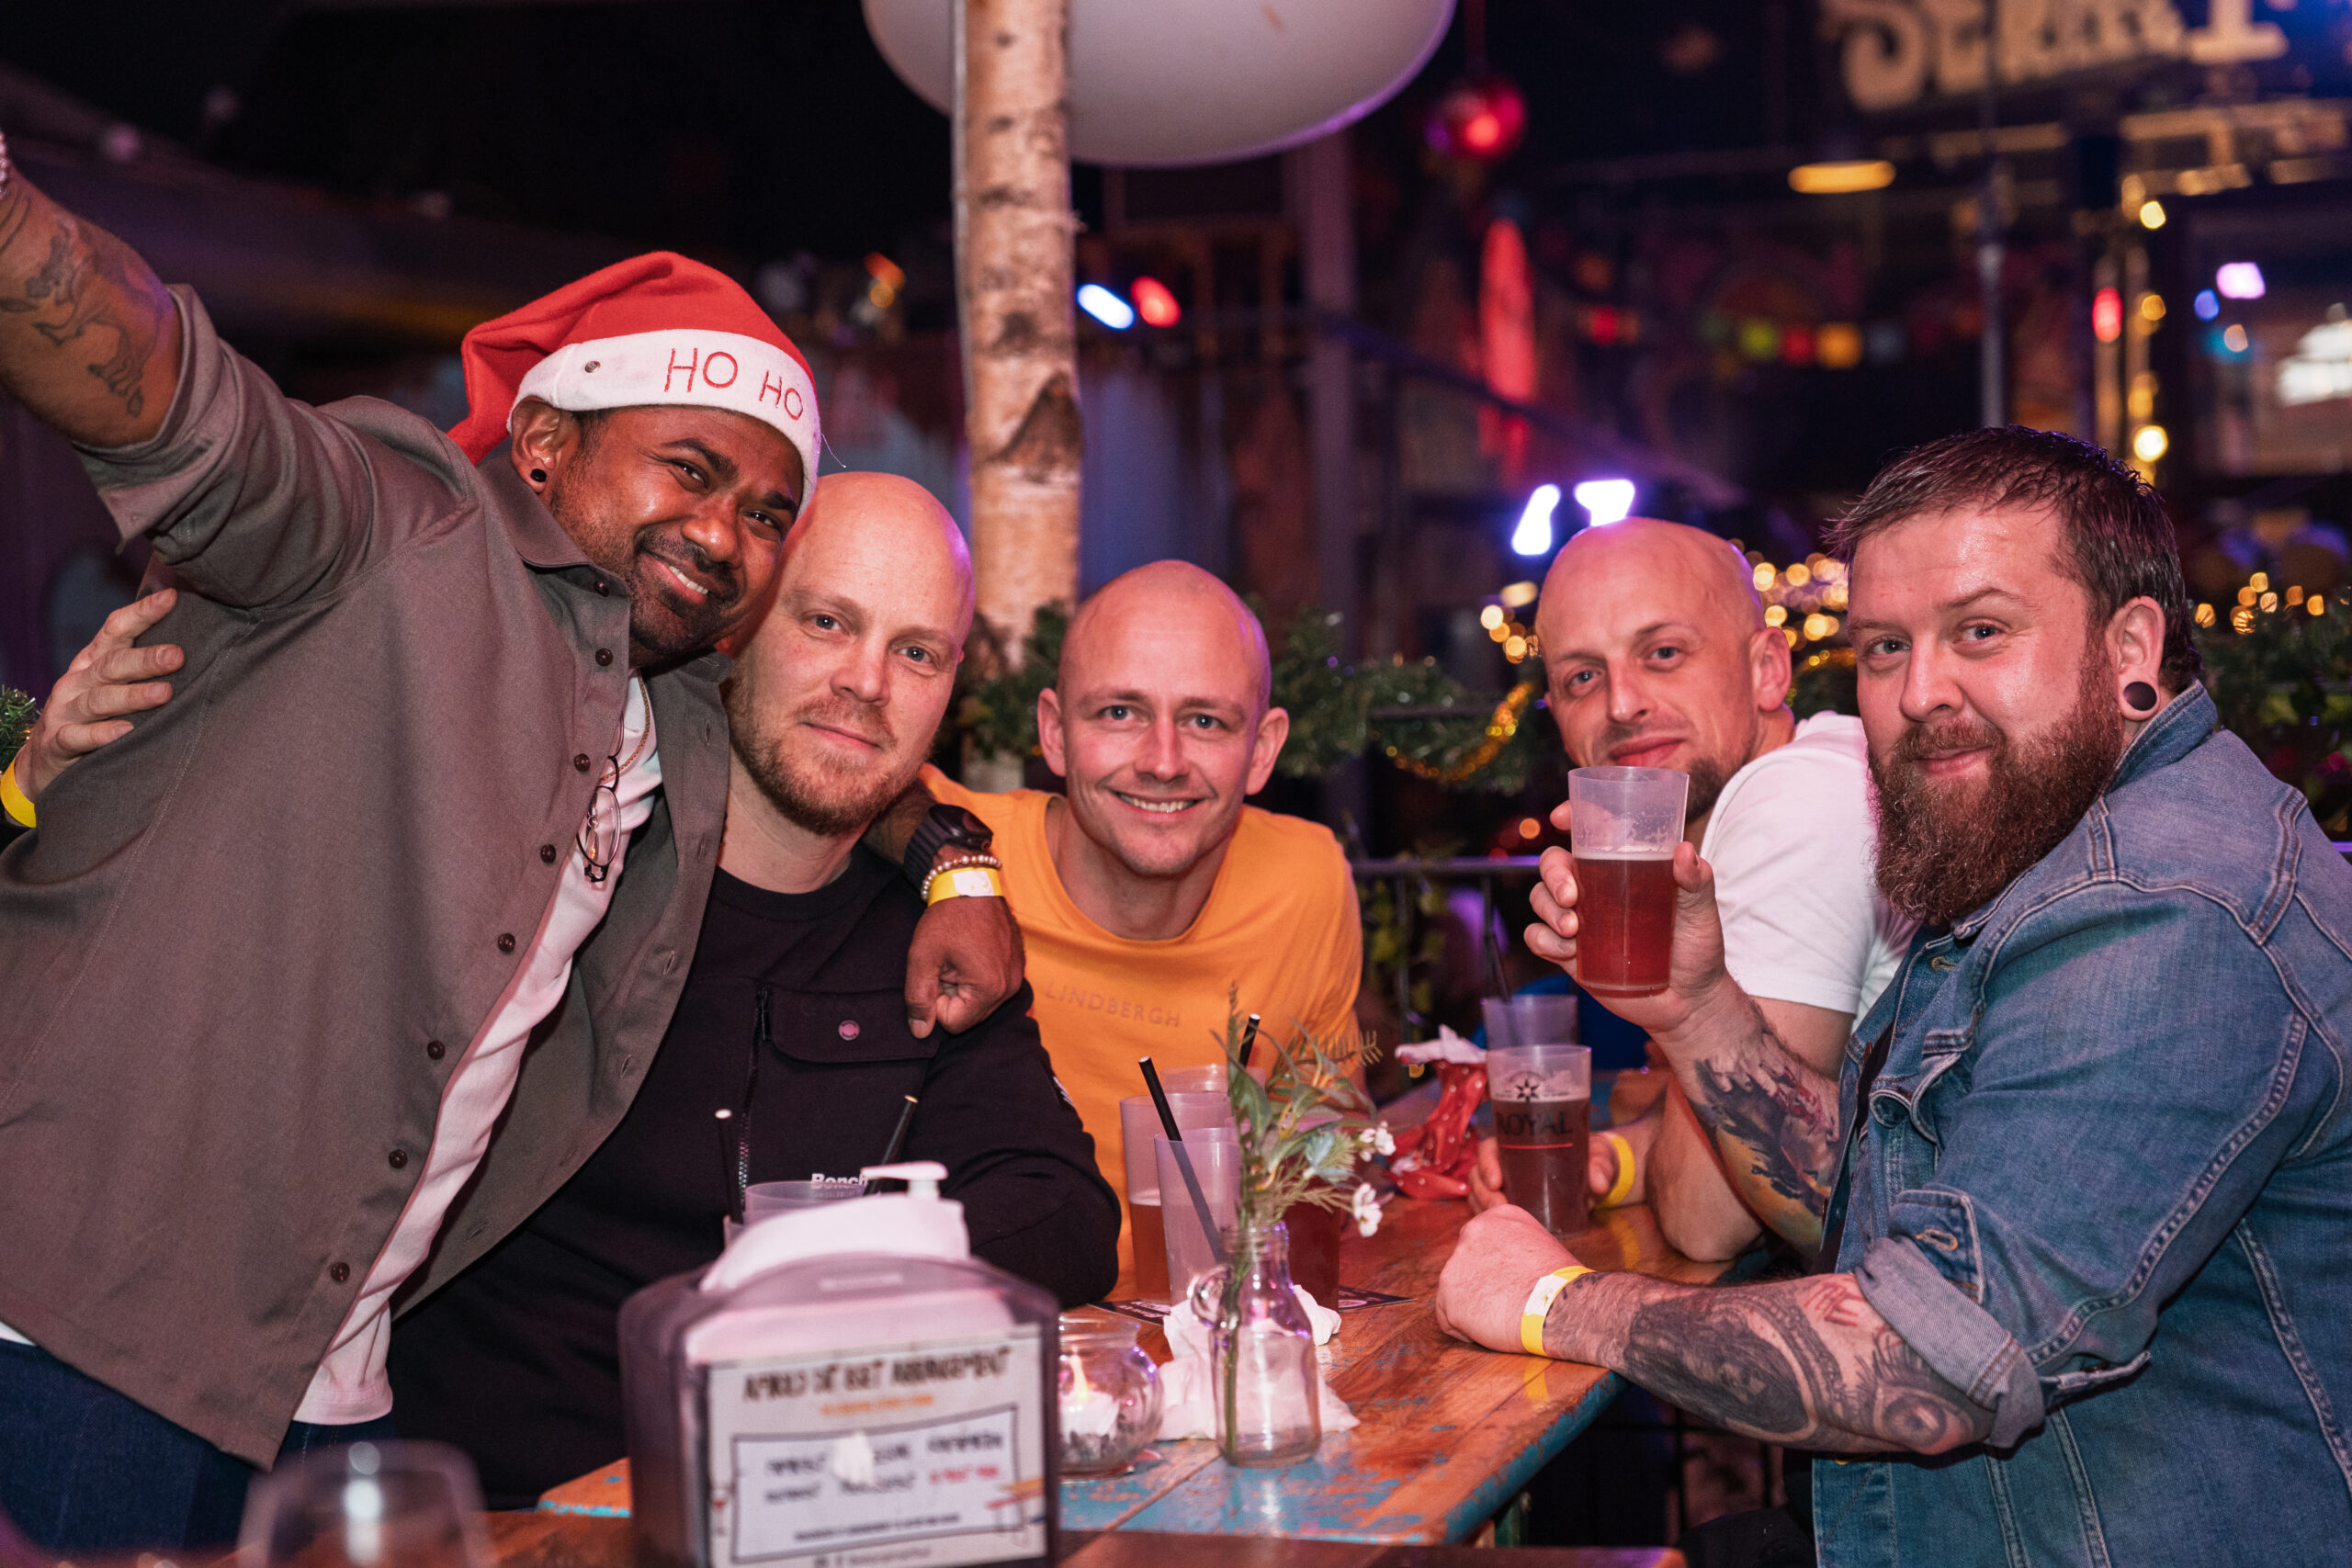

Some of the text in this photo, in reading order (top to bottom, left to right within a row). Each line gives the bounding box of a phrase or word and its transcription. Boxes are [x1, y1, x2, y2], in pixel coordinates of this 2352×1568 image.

[663, 347, 804, 421] HO HO
[1045, 983, 1182, 1028] LINDBERGH
